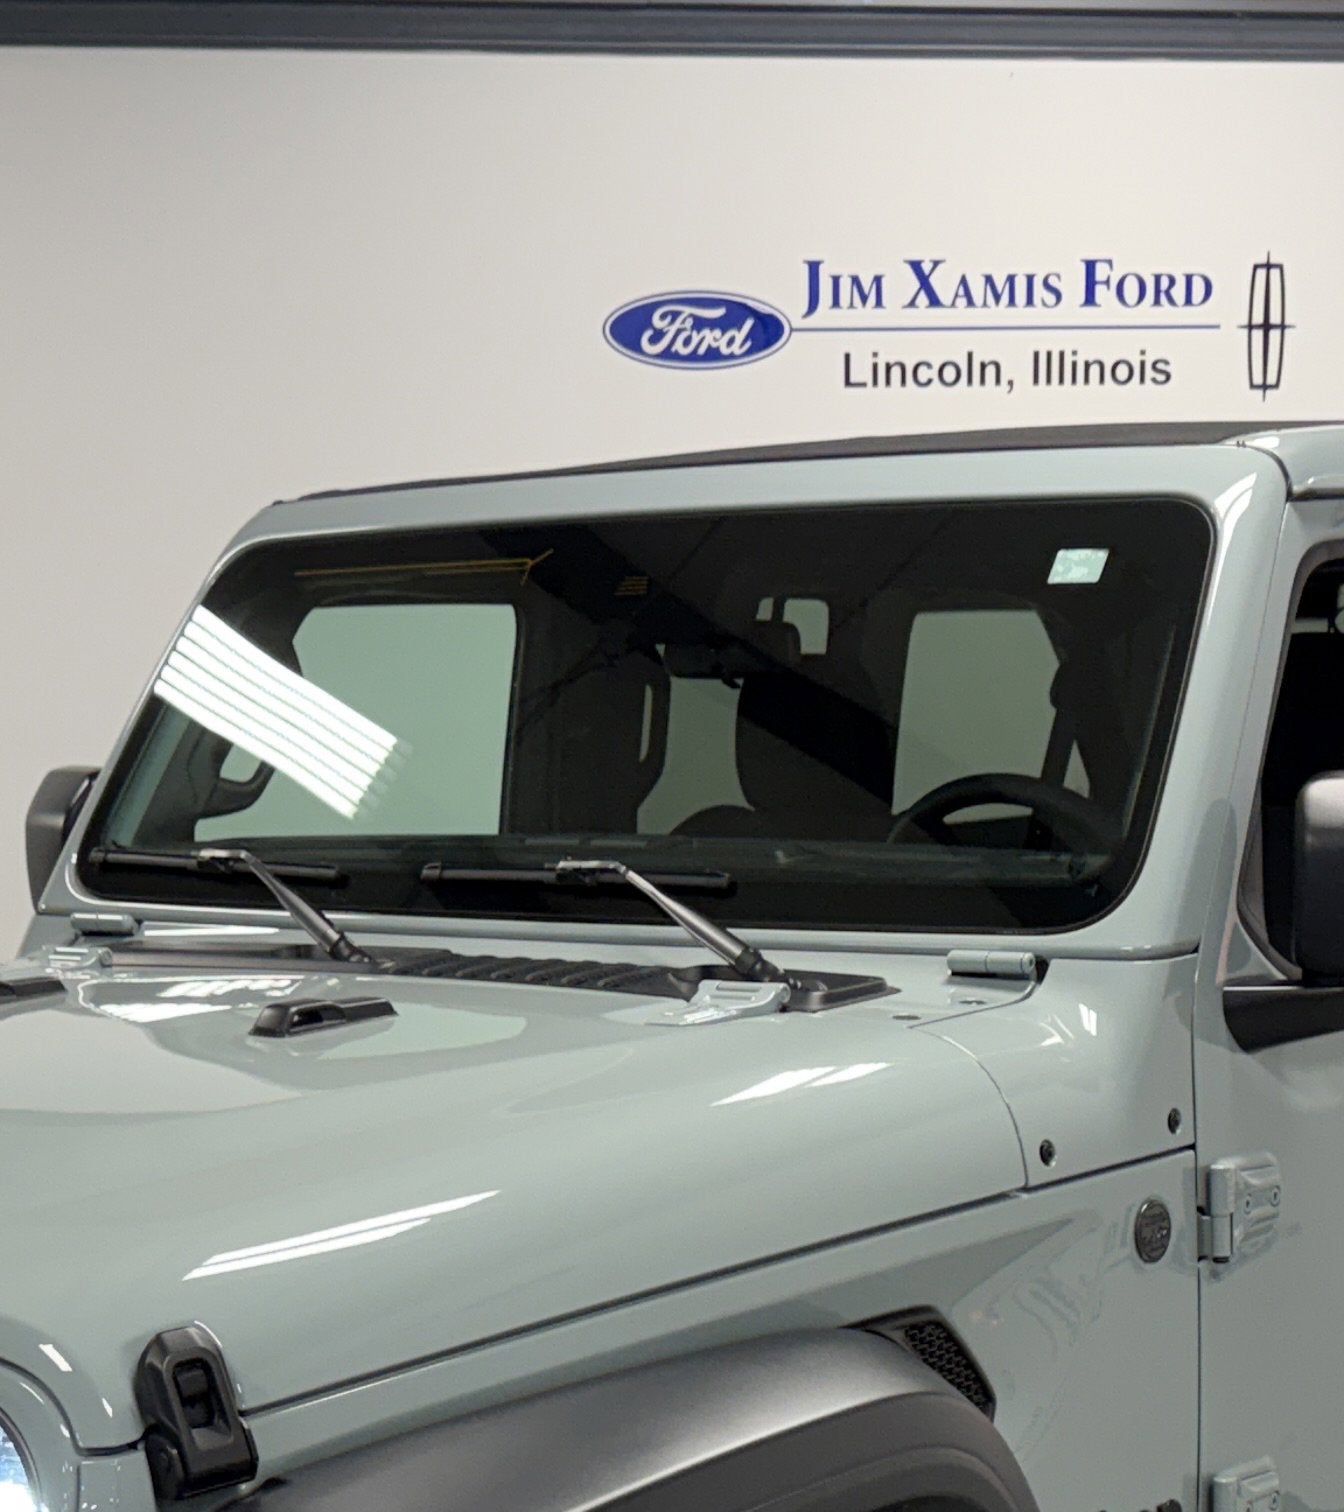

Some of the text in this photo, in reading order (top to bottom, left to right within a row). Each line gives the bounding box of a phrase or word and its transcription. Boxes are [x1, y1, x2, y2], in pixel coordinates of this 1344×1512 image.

[801, 258, 1214, 319] JIM XAMIS FORD
[640, 305, 755, 356] Ford
[843, 349, 1172, 394] Lincoln, Illinois
